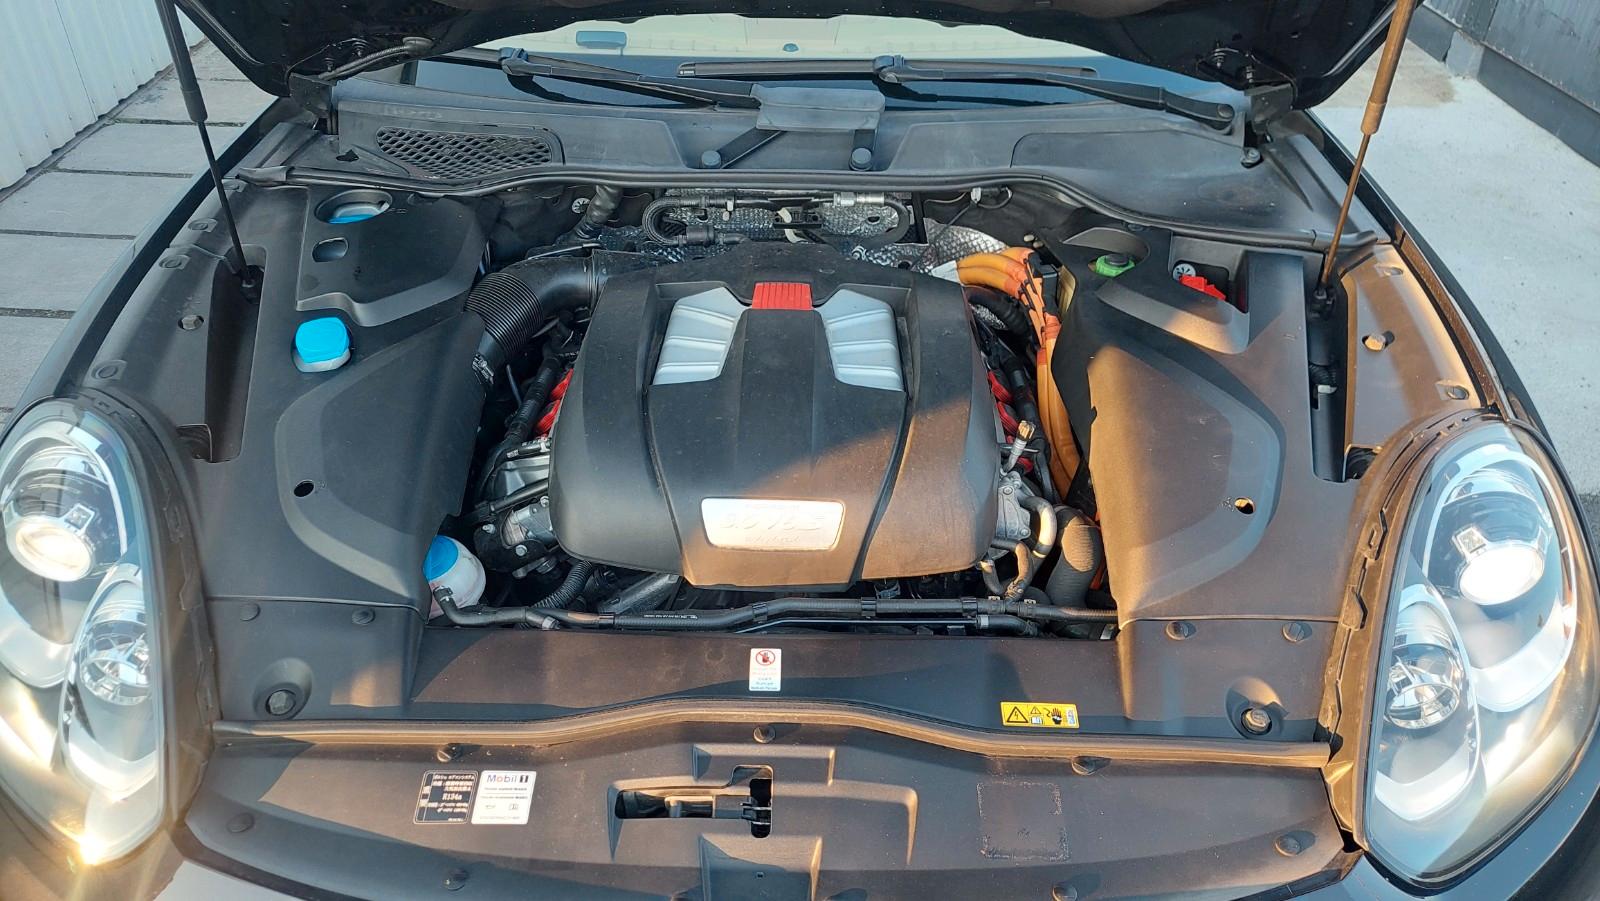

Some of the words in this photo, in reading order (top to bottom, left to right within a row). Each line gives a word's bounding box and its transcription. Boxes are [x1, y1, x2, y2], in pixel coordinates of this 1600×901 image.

[487, 774, 518, 783] Mobil
[519, 774, 529, 783] 1
[442, 793, 462, 801] R134a
